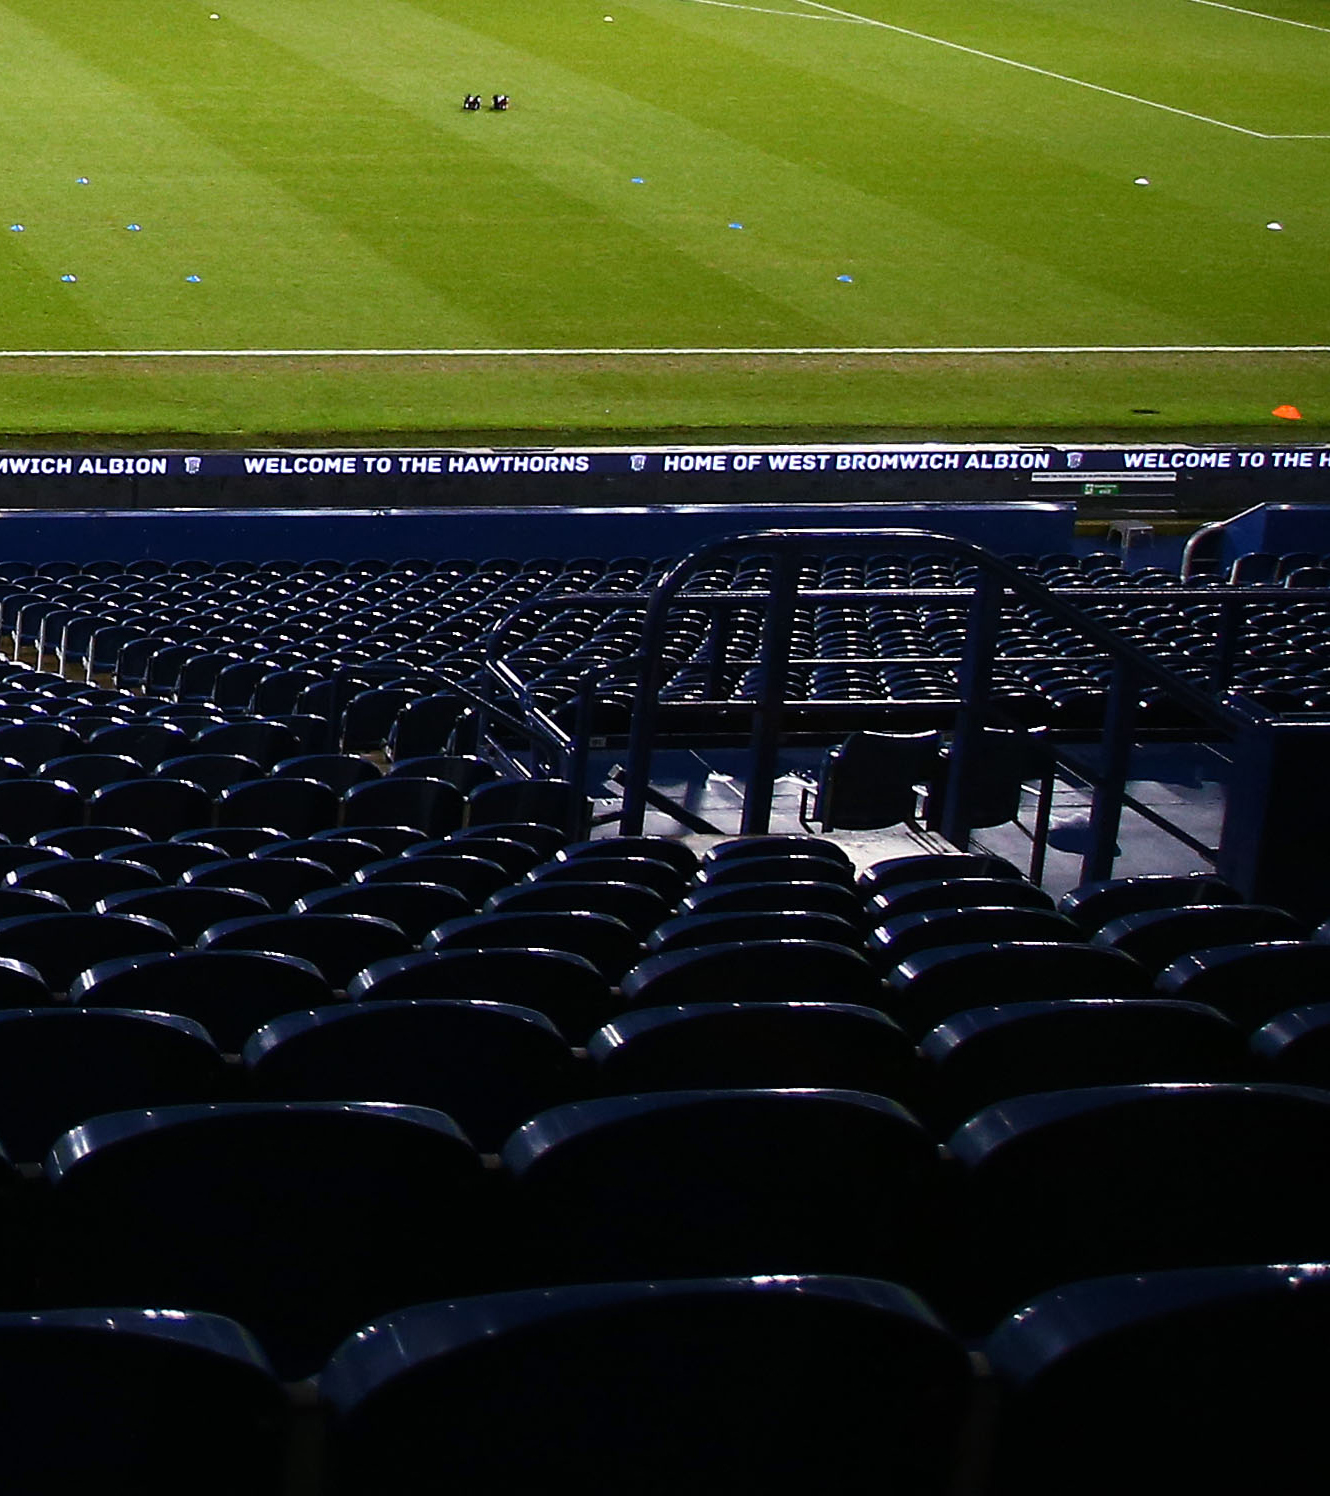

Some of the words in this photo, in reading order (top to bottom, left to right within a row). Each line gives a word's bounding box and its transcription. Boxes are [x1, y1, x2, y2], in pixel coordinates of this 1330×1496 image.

[79, 458, 166, 473] ALBION
[245, 458, 356, 473] WELCOME
[364, 458, 391, 472] TO
[399, 457, 441, 472] THE
[449, 456, 588, 472] HAWTHORNS
[665, 456, 727, 471] HOME
[734, 455, 762, 470] OF
[769, 455, 830, 470] WEST
[836, 454, 959, 469] BROMWICH
[965, 454, 1049, 468] ALBION
[1124, 453, 1231, 467] WELCOME
[1238, 453, 1264, 467] TO
[1272, 453, 1313, 467] THE
